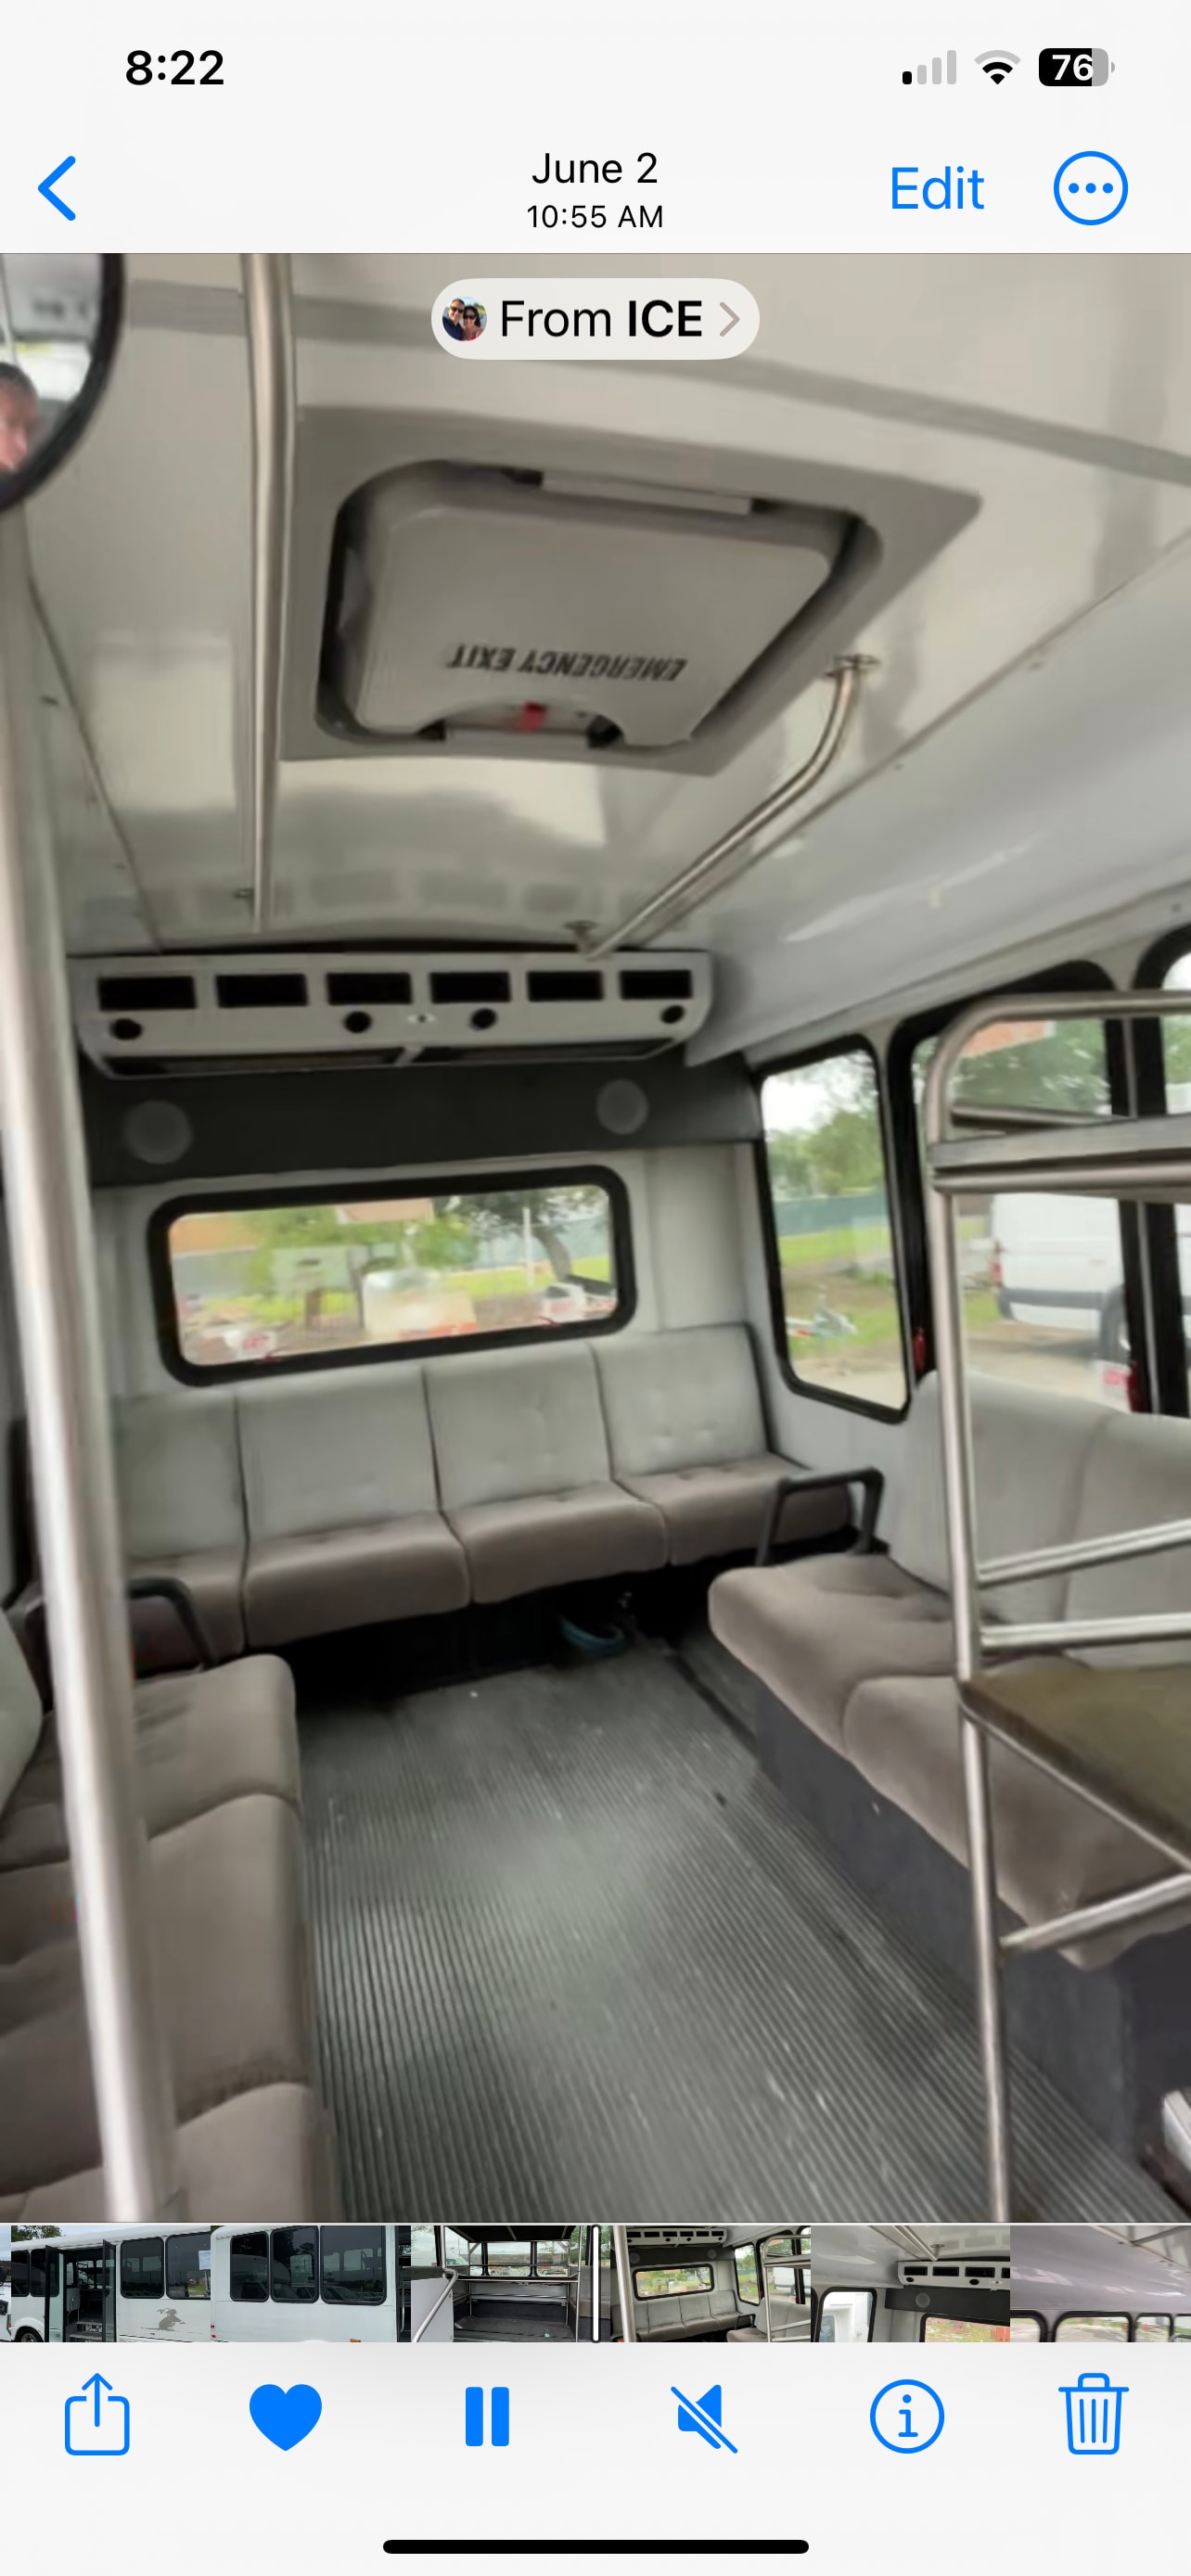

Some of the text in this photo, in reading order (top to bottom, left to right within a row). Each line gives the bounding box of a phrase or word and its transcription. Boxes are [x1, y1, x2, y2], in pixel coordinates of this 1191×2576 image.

[125, 49, 225, 86] 8:22
[1052, 54, 1094, 81] 76
[531, 152, 658, 185] June 2
[891, 165, 985, 210] Edit
[527, 204, 663, 229] 10:55 AM
[502, 299, 702, 338] From ICE
[445, 644, 688, 682] EMERGENCY EXIT
